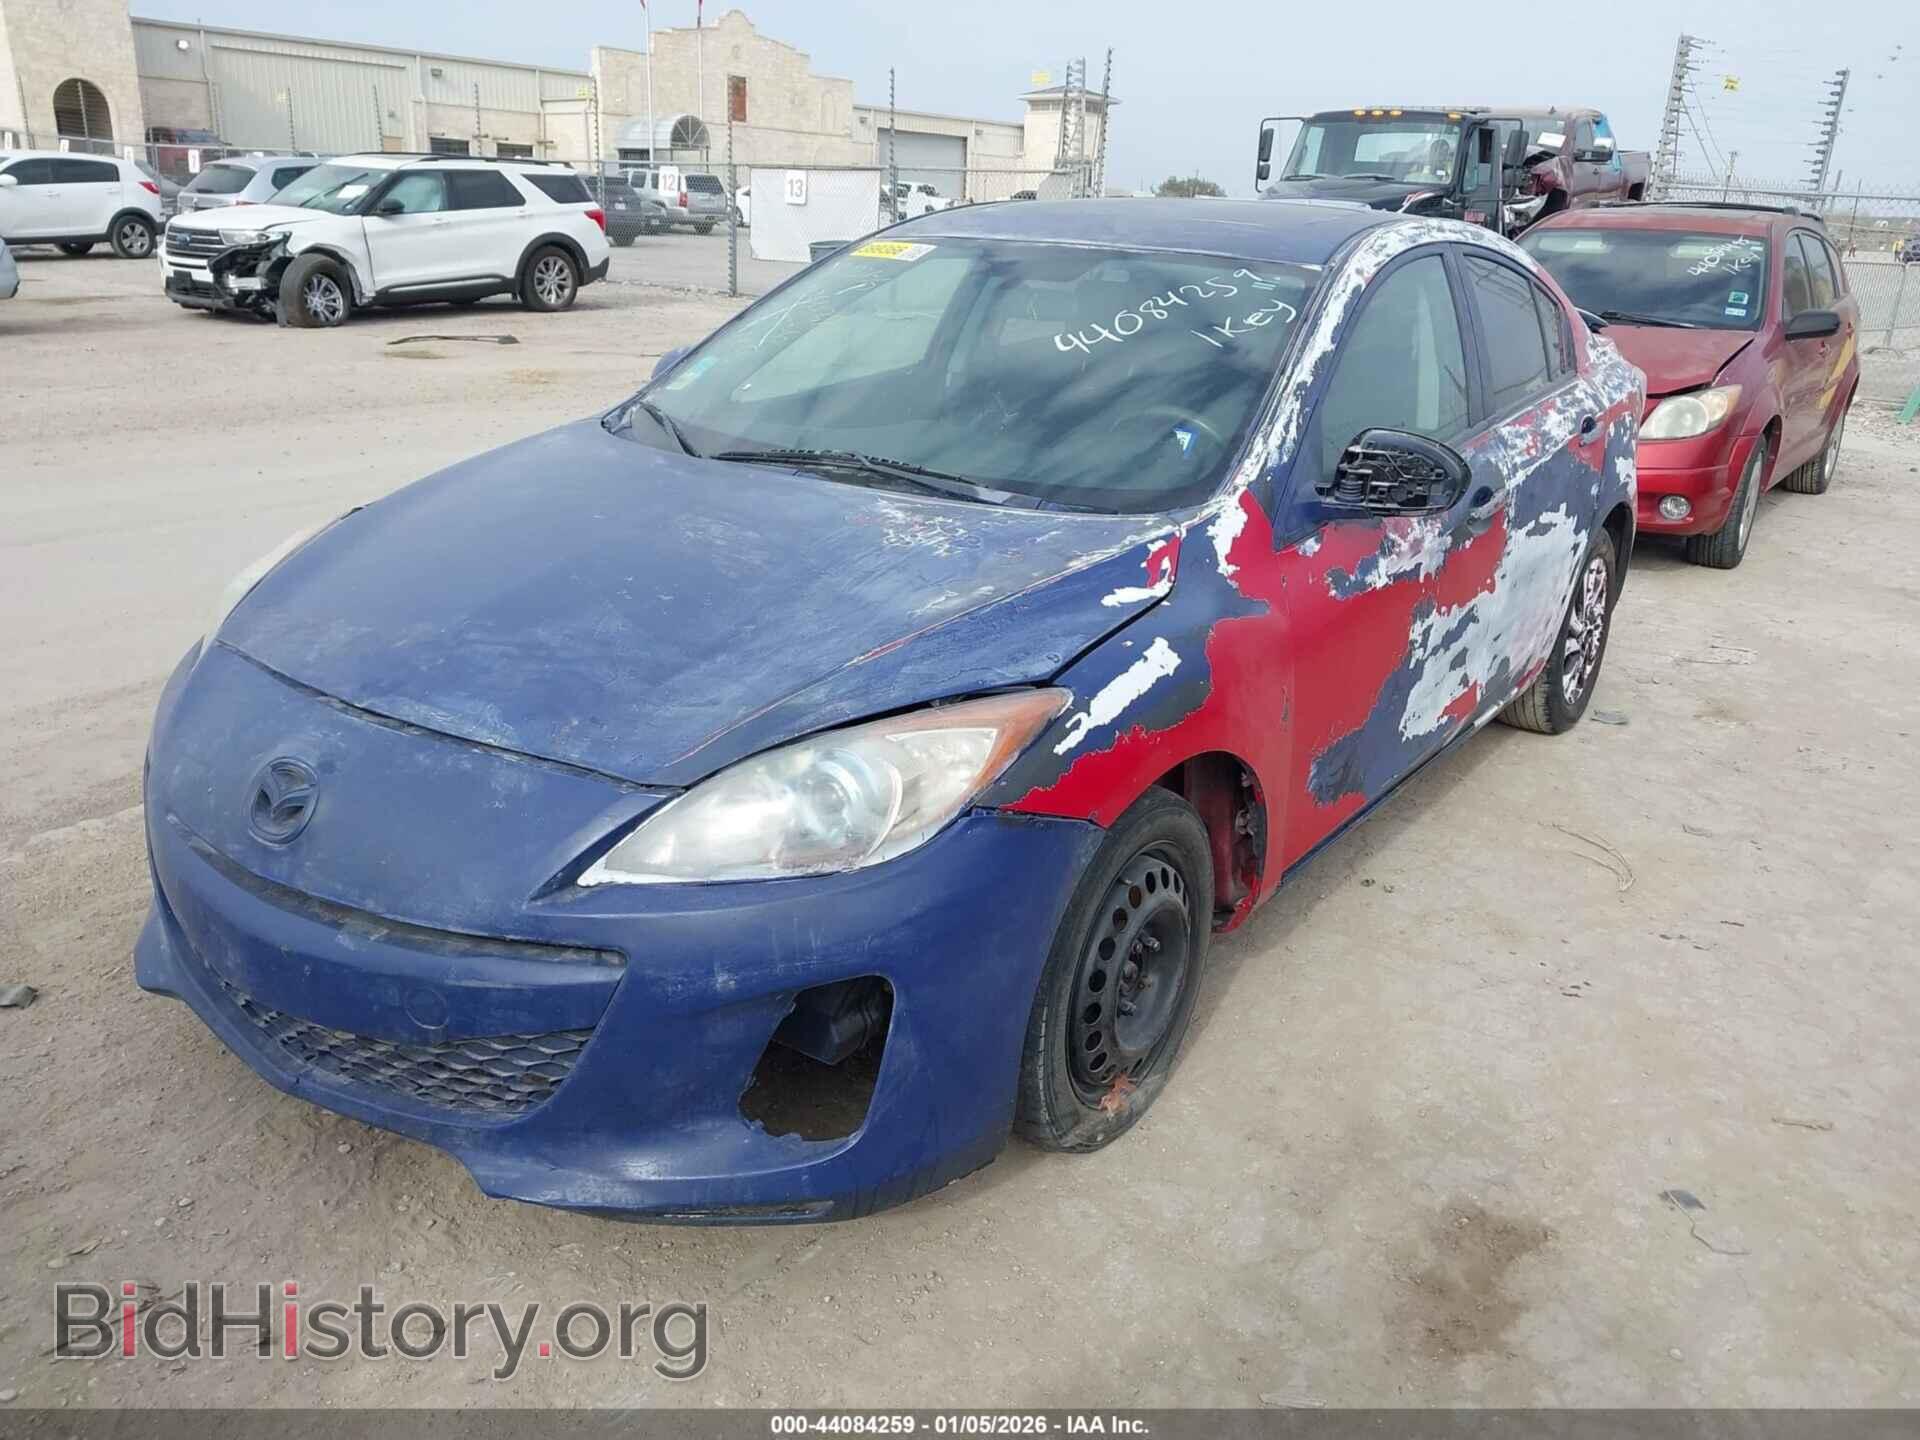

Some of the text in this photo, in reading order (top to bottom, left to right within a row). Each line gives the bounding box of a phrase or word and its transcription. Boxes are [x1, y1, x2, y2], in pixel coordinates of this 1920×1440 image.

[661, 174, 676, 192] 12
[787, 178, 804, 198] 13
[1054, 268, 1264, 353] 44084259
[1213, 299, 1297, 338] Key
